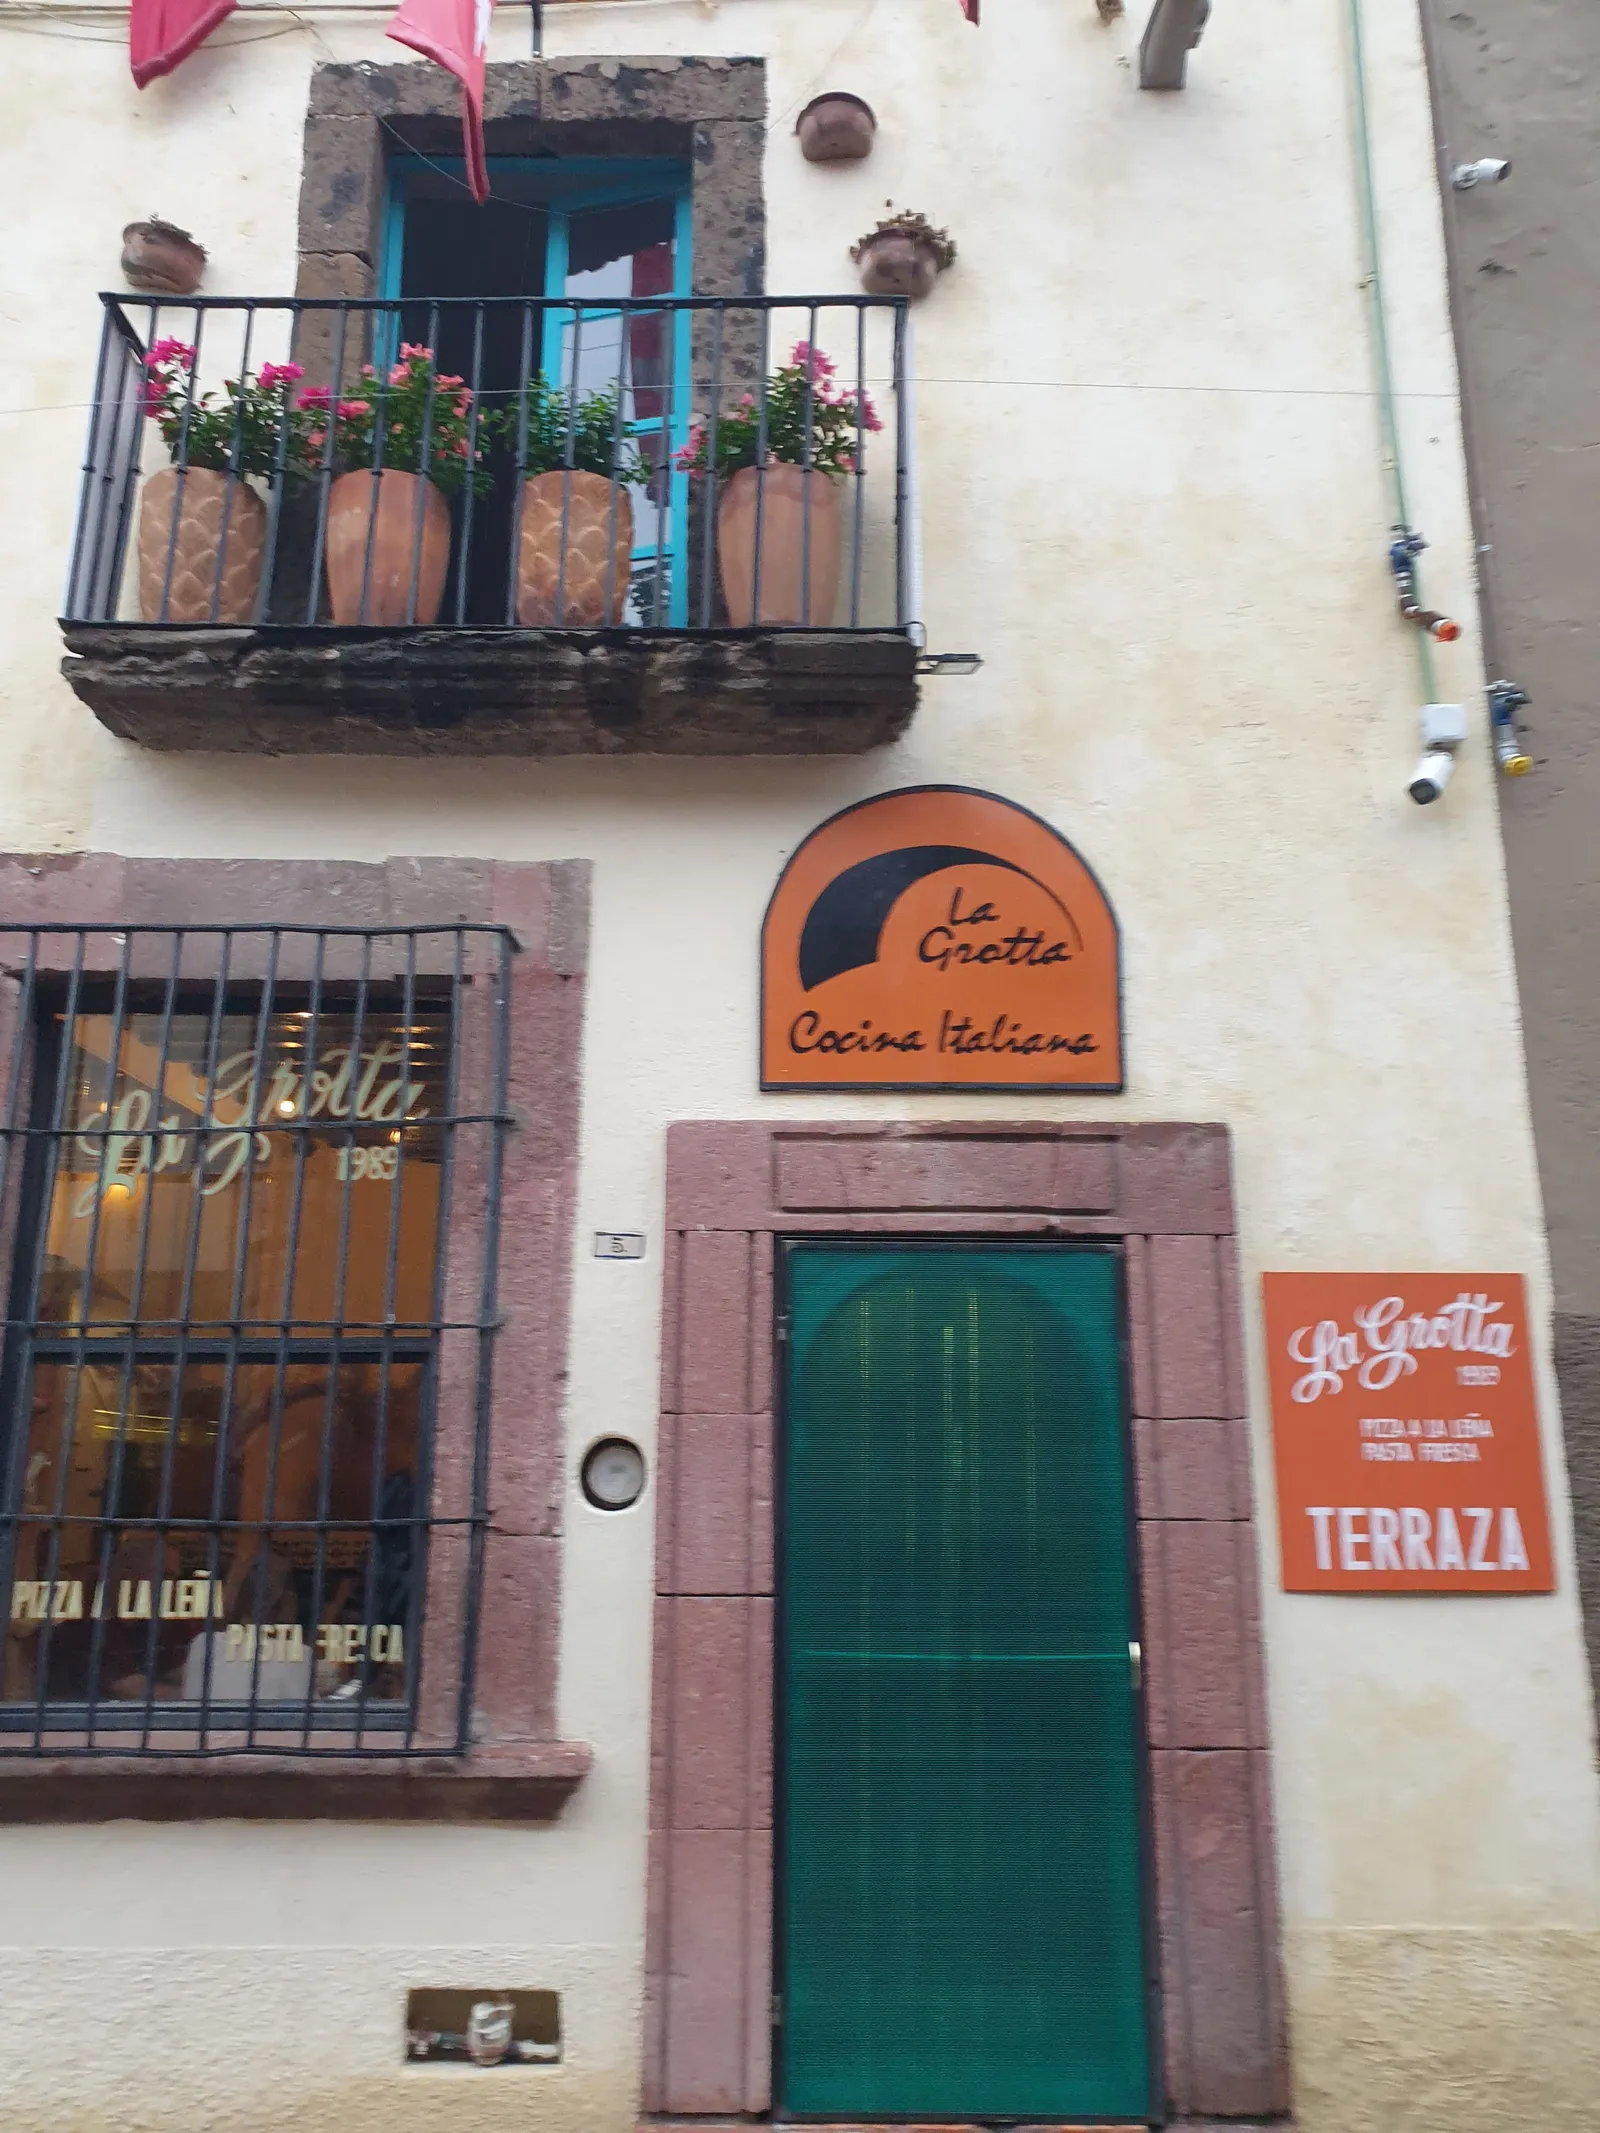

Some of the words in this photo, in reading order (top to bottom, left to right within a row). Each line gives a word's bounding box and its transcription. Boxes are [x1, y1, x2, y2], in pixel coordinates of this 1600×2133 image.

[949, 886, 1001, 926] La
[917, 925, 1073, 972] Grotta
[788, 1009, 928, 1055] Cocina
[937, 1008, 1101, 1056] Italiana
[336, 1146, 400, 1181] 1989
[1287, 1319, 1366, 1403] La
[1352, 1292, 1518, 1391] Grotta
[1305, 1506, 1531, 1571] TERRAZA
[10, 1580, 83, 1619] PIZZA
[117, 1580, 152, 1619] LA
[225, 1623, 304, 1663] PASTA
